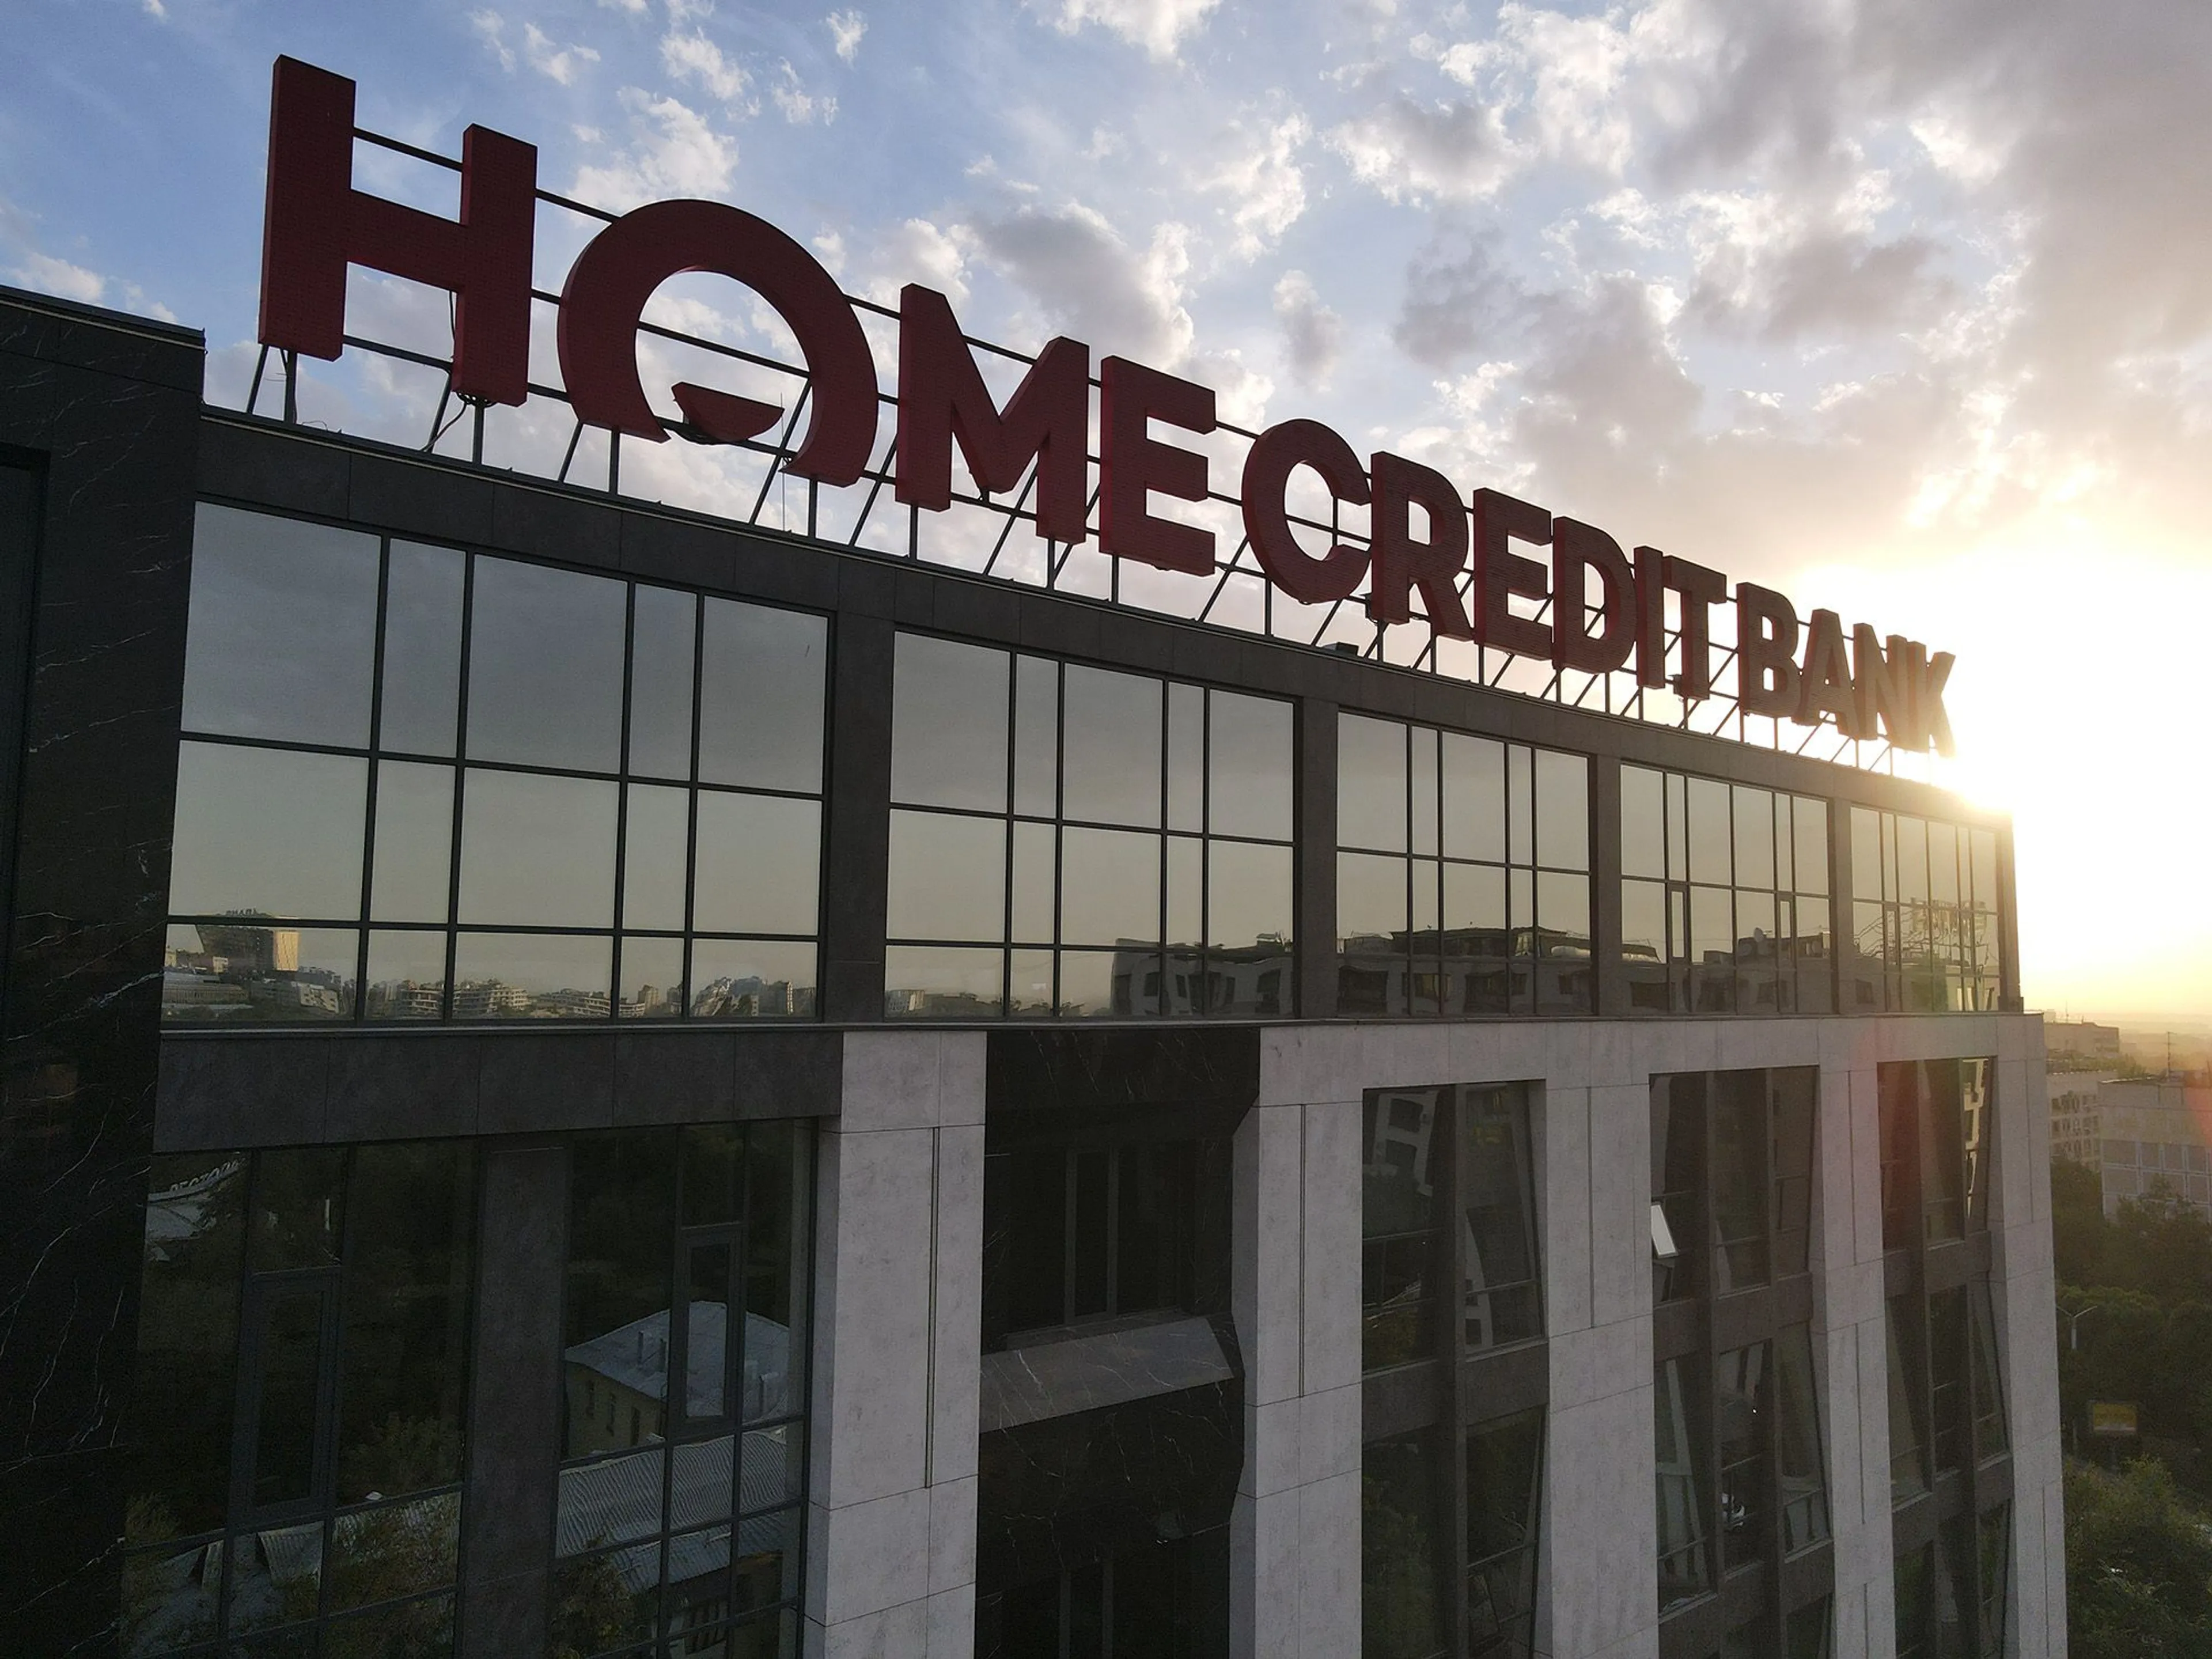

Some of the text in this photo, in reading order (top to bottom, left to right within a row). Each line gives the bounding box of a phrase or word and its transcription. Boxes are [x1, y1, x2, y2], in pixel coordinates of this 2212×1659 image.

[259, 54, 1956, 757] HOME CREDIT BANK
